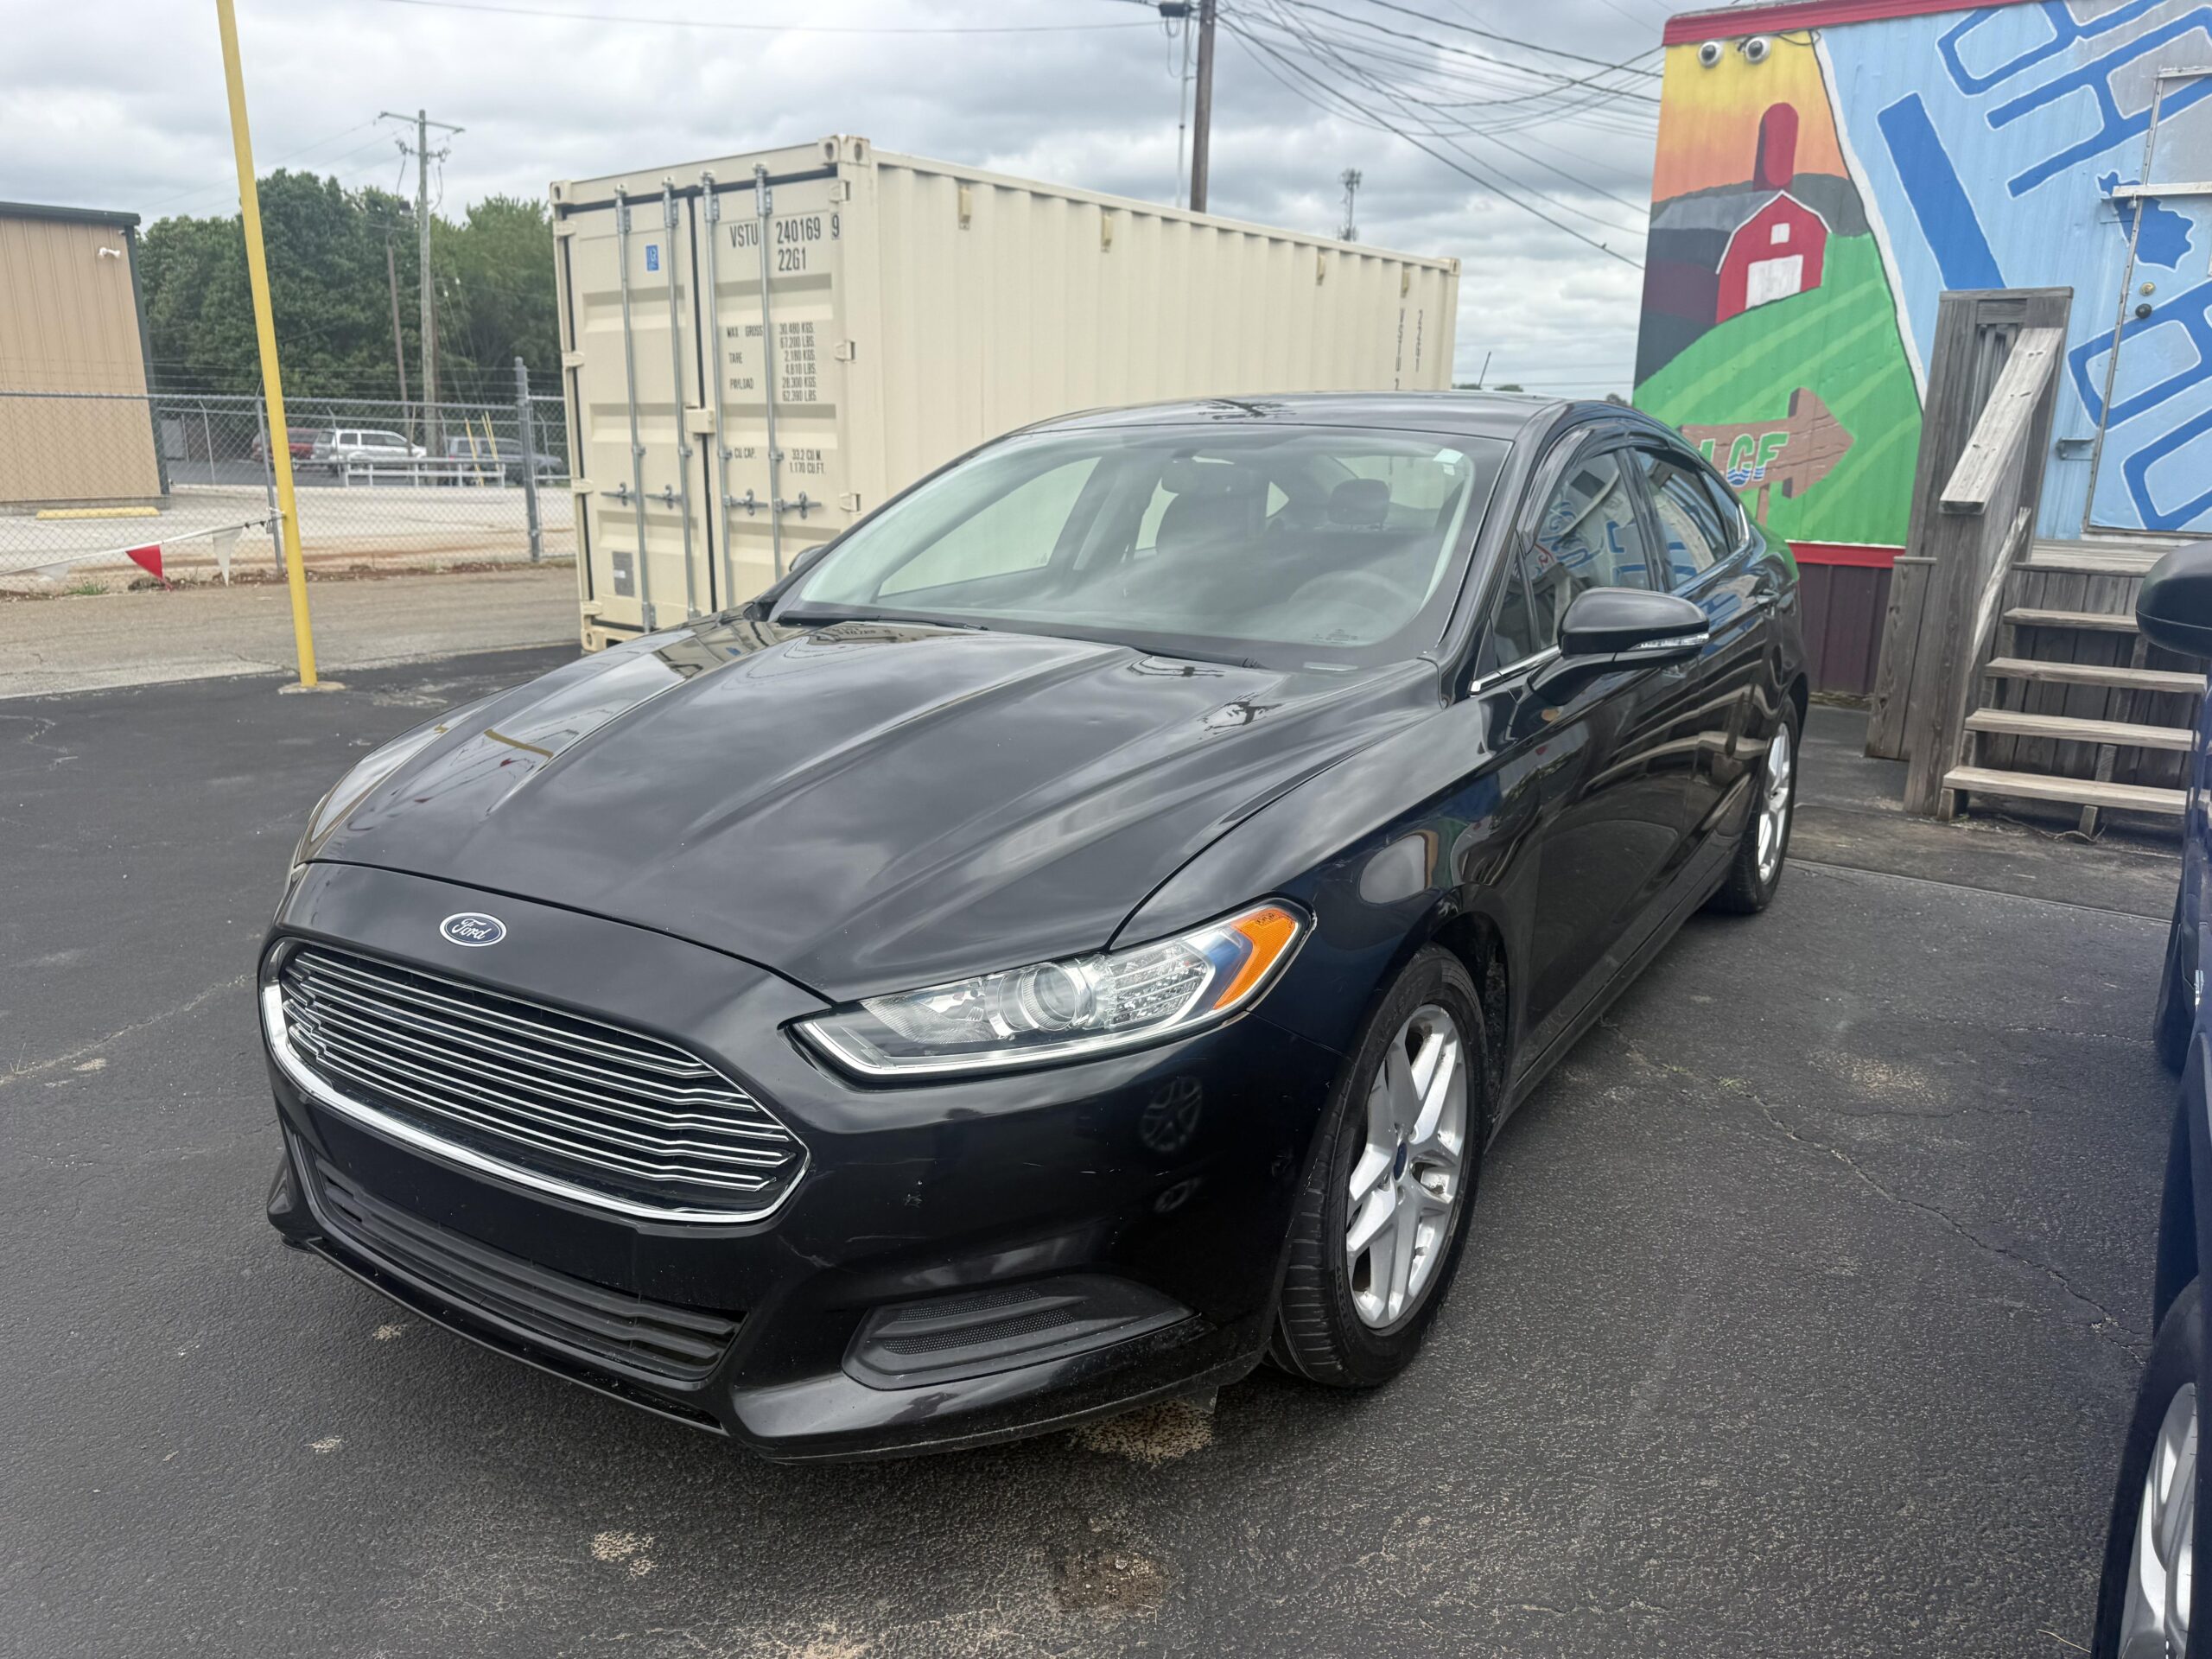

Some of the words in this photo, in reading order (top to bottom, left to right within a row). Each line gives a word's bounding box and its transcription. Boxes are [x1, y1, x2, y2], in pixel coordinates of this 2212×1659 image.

[729, 223, 760, 249] VSTU
[776, 216, 822, 245] 240169
[831, 213, 841, 239] 9
[778, 246, 807, 272] 22G1
[745, 324, 763, 337] GROSS
[728, 352, 743, 364] TARE
[729, 377, 753, 391] PAYLOAD
[451, 918, 492, 940] Ford
